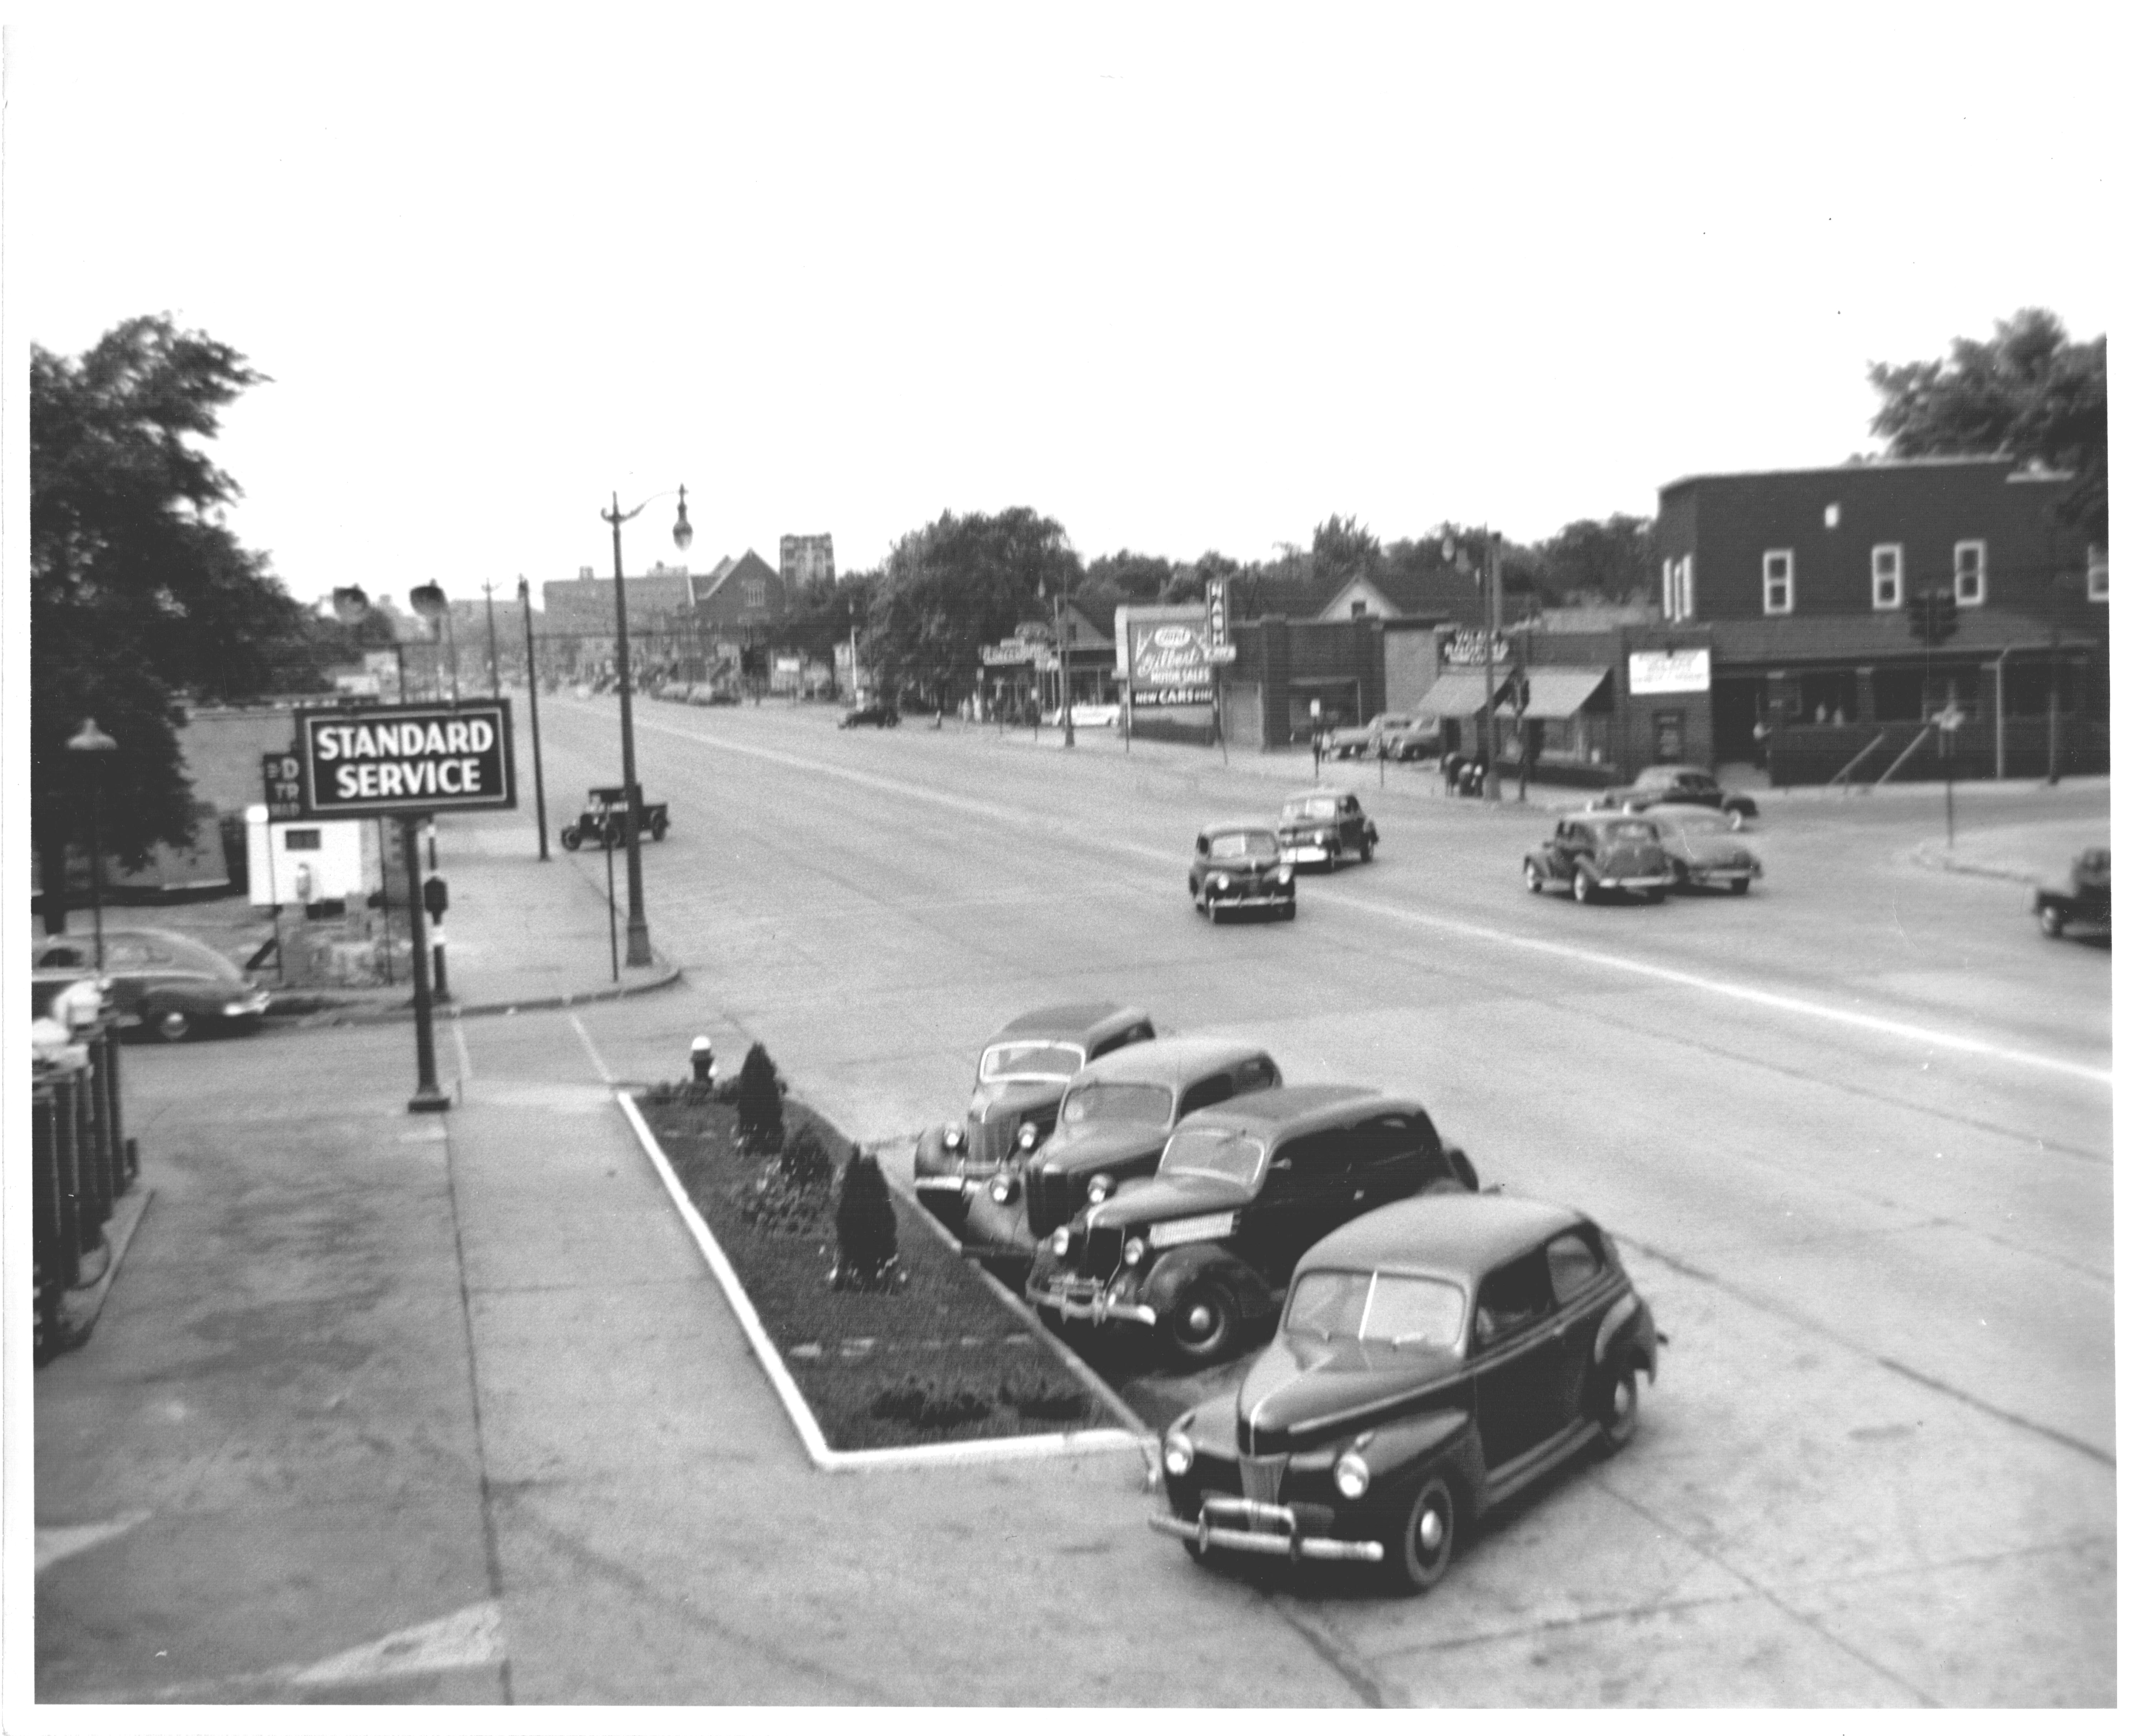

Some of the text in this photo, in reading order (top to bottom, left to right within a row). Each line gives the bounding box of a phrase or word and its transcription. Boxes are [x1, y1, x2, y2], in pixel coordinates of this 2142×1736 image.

[1135, 691, 1157, 705] NEW
[1158, 688, 1194, 704] CARS
[317, 719, 494, 760] STANDARD
[336, 759, 482, 799] SERVICE
